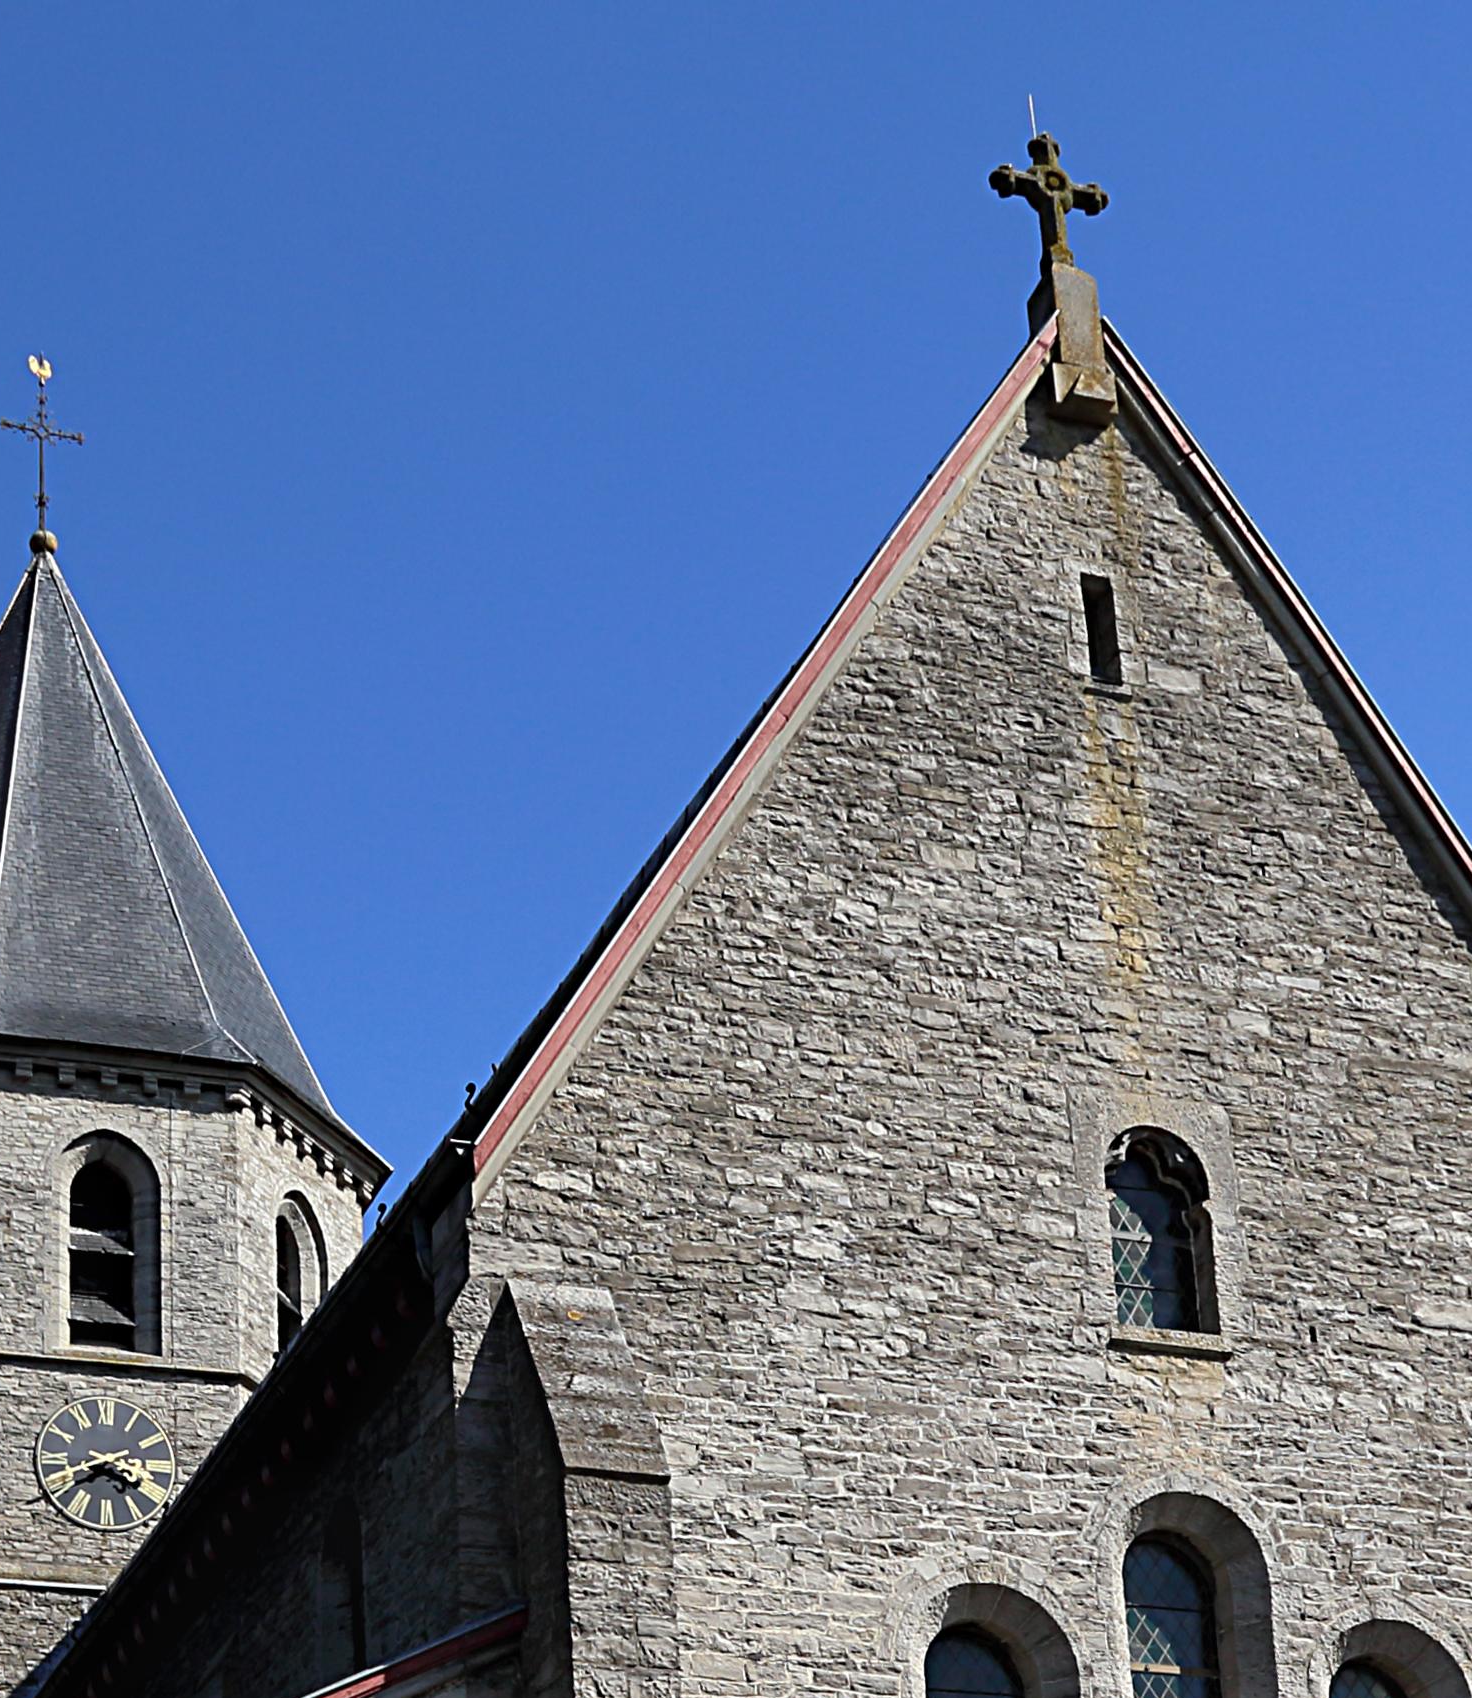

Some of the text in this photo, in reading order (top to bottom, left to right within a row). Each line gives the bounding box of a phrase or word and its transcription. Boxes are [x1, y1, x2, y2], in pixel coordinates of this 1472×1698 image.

[69, 1403, 92, 1431] XI
[97, 1399, 115, 1426] XII
[124, 1410, 141, 1432] I
[48, 1422, 75, 1444] X
[138, 1433, 165, 1450] II
[41, 1450, 68, 1465] IX
[146, 1459, 172, 1474] III
[67, 1489, 92, 1519] VII
[100, 1499, 115, 1526] VI
[125, 1495, 143, 1521] V
